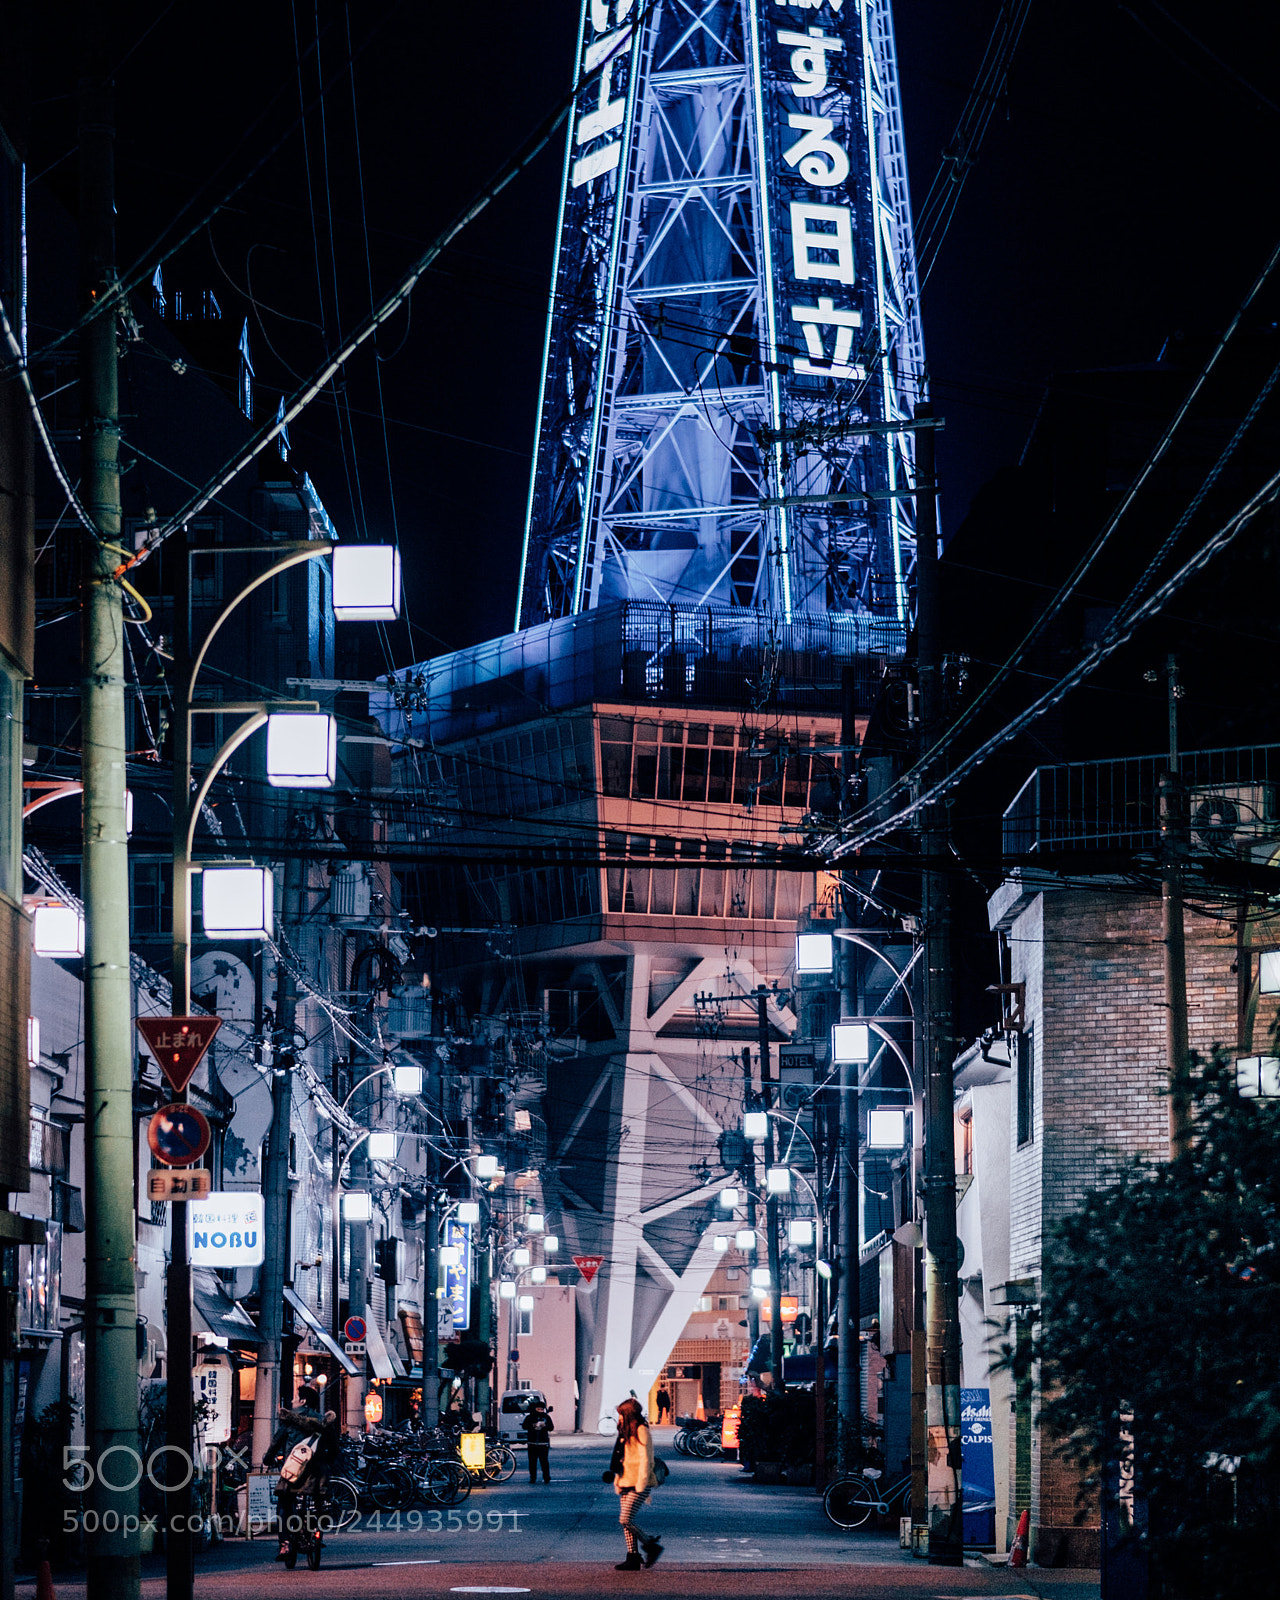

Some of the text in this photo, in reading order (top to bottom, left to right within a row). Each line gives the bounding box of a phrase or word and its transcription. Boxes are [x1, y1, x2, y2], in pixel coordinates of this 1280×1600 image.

[775, 0, 867, 381] する日立
[155, 1032, 204, 1049] 止まれ
[781, 1056, 812, 1067] HOTEL
[150, 1178, 208, 1193] 自動車
[194, 1231, 257, 1248] NOBU
[961, 1404, 992, 1417] Asahi
[961, 1435, 993, 1445] CALPIS
